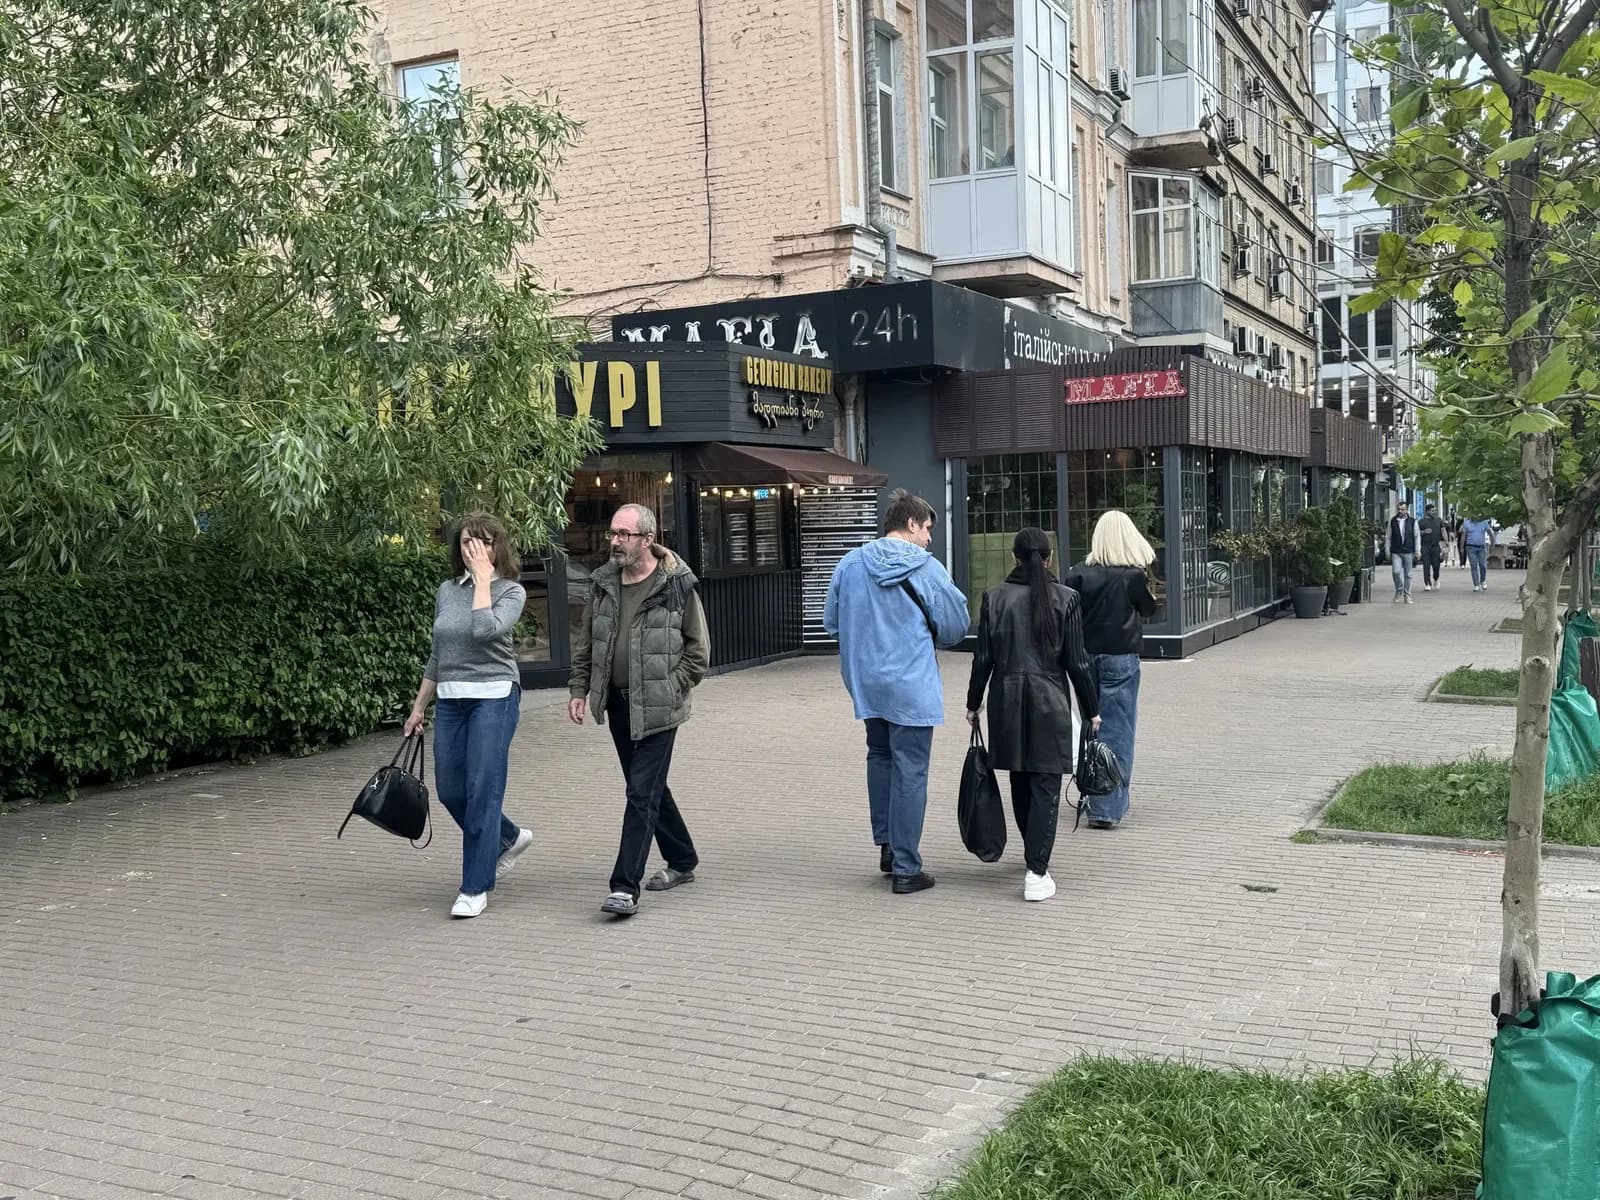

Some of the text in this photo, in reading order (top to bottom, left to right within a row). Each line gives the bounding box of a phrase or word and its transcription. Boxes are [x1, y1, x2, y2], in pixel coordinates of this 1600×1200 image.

[849, 303, 919, 346] 24h
[745, 355, 833, 395] GEORGIAN BAKERY
[1064, 370, 1187, 403] MAFIA
